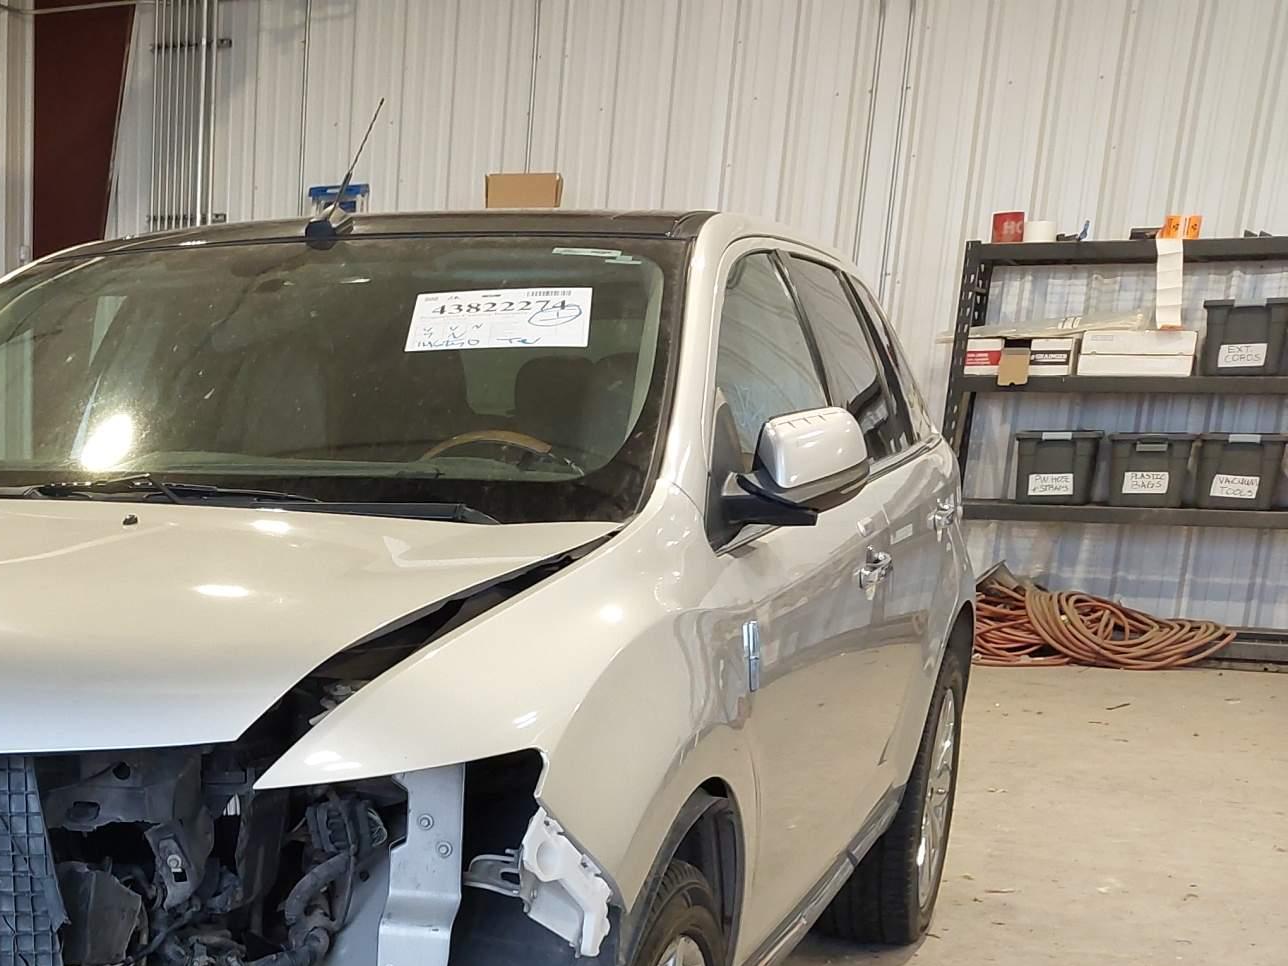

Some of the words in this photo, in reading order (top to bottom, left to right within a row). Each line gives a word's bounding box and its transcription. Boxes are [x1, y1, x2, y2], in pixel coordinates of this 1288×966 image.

[432, 299, 566, 315] 43822274
[1224, 353, 1261, 362] CORDS
[1131, 472, 1166, 480] PLASTIC
[1132, 480, 1162, 489] BAGS
[1219, 486, 1253, 496] TOOLS
